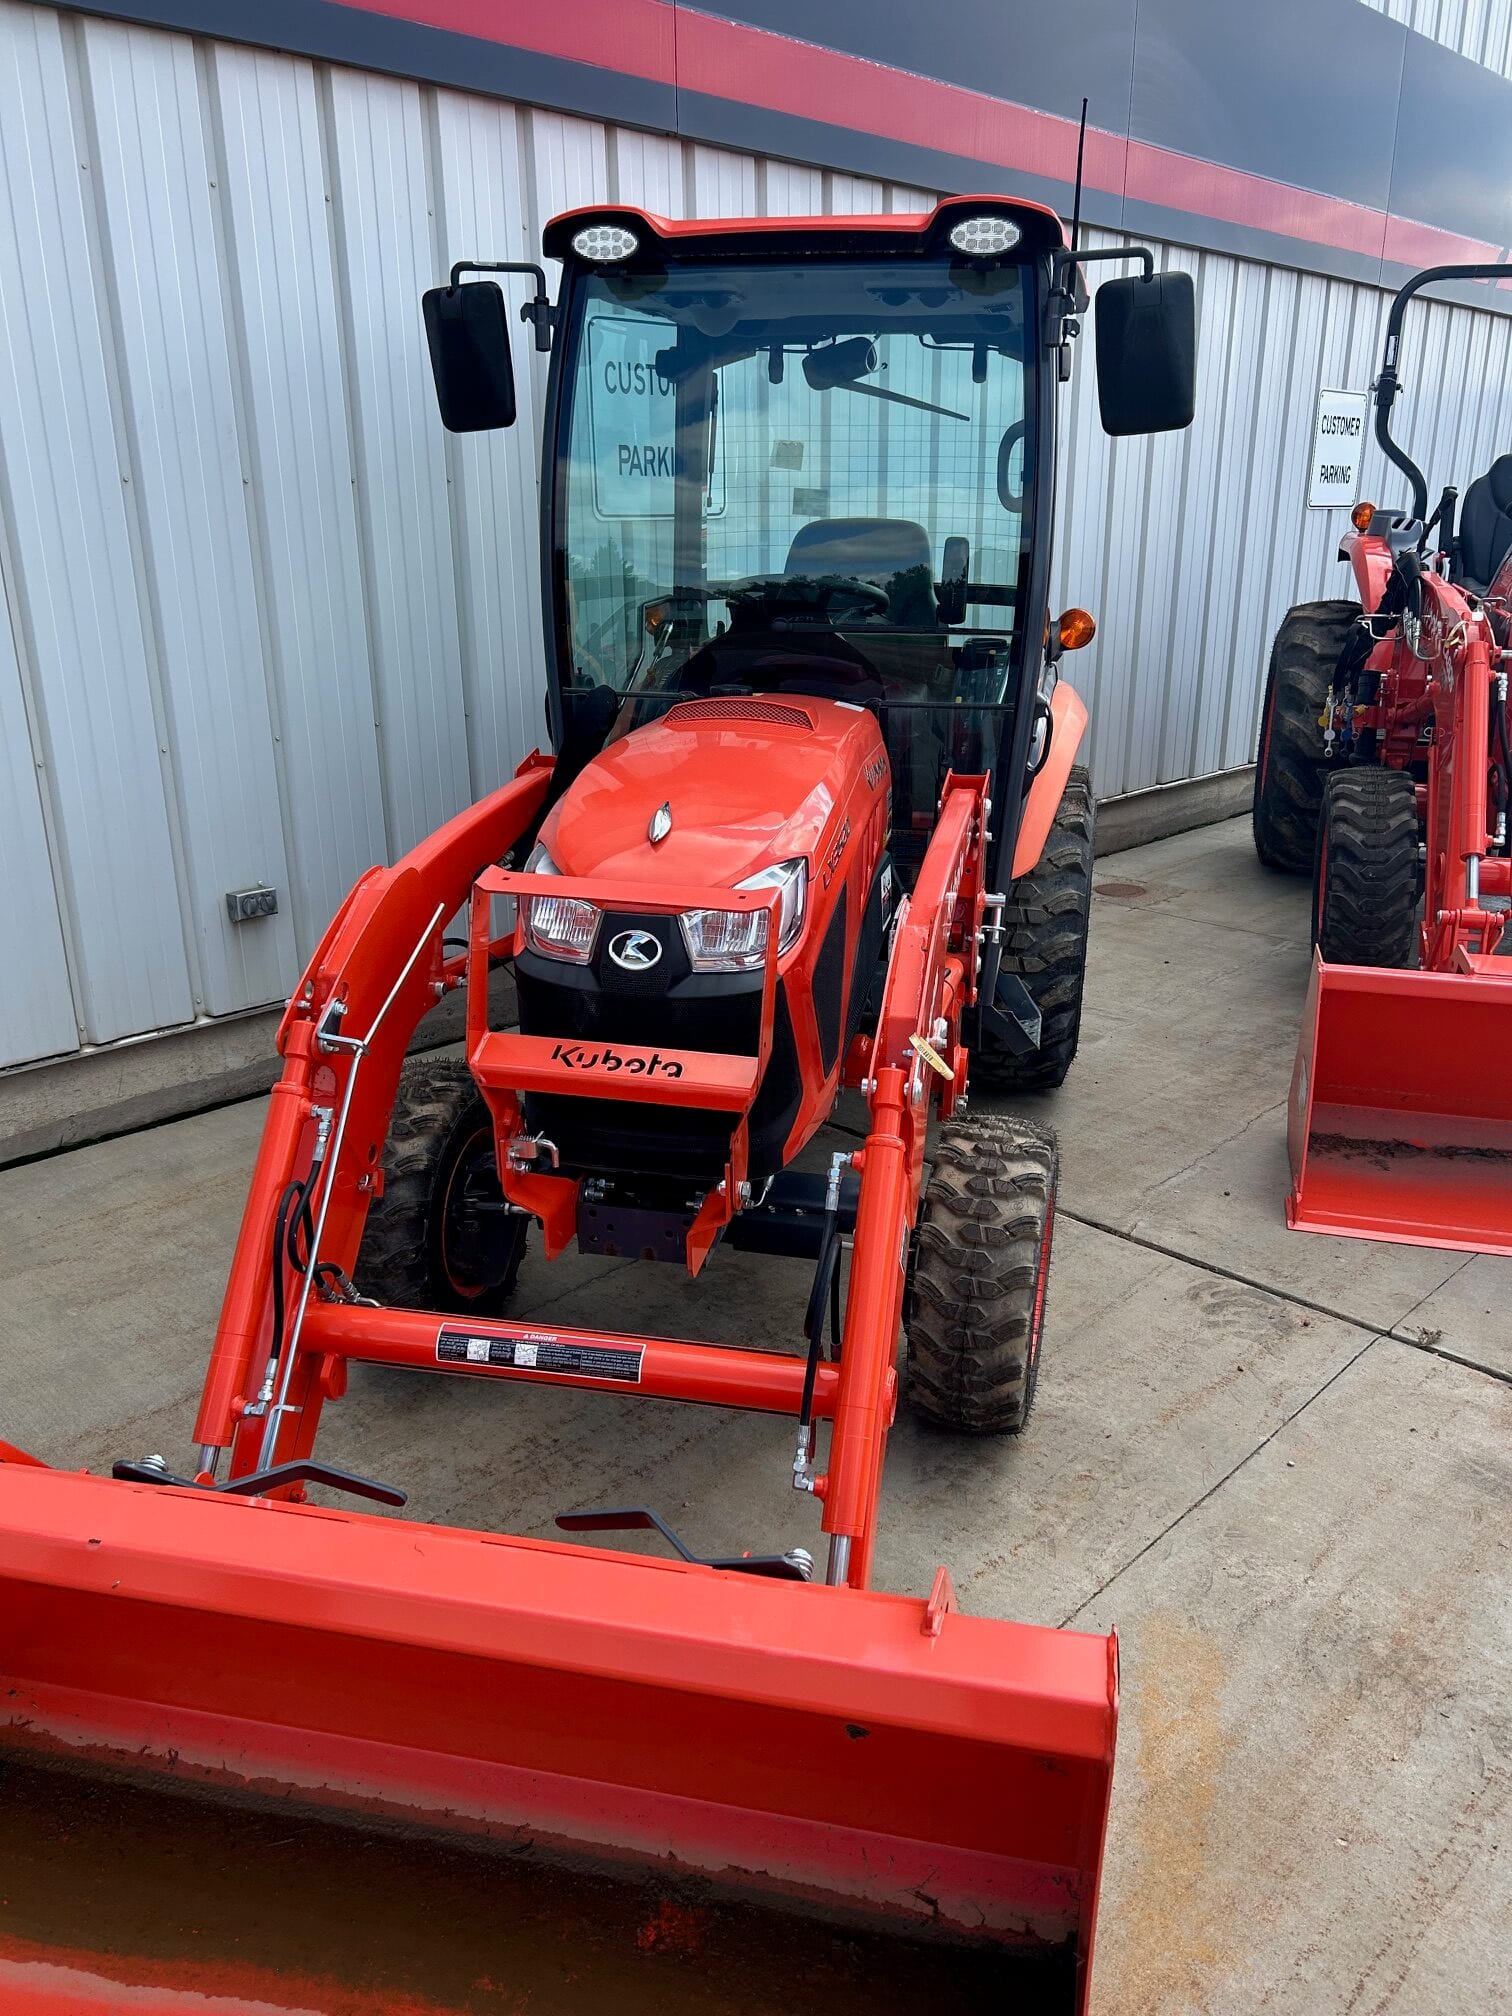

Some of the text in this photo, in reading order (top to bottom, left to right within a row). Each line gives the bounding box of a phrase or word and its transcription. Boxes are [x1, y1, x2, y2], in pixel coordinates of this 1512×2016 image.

[604, 361, 677, 397] CUSTO
[1321, 414, 1361, 437] CUSTOMER
[618, 444, 675, 477] PARKI
[1320, 464, 1351, 484] PARKING
[551, 1044, 683, 1078] Kubota
[529, 1334, 558, 1342] DANGER
